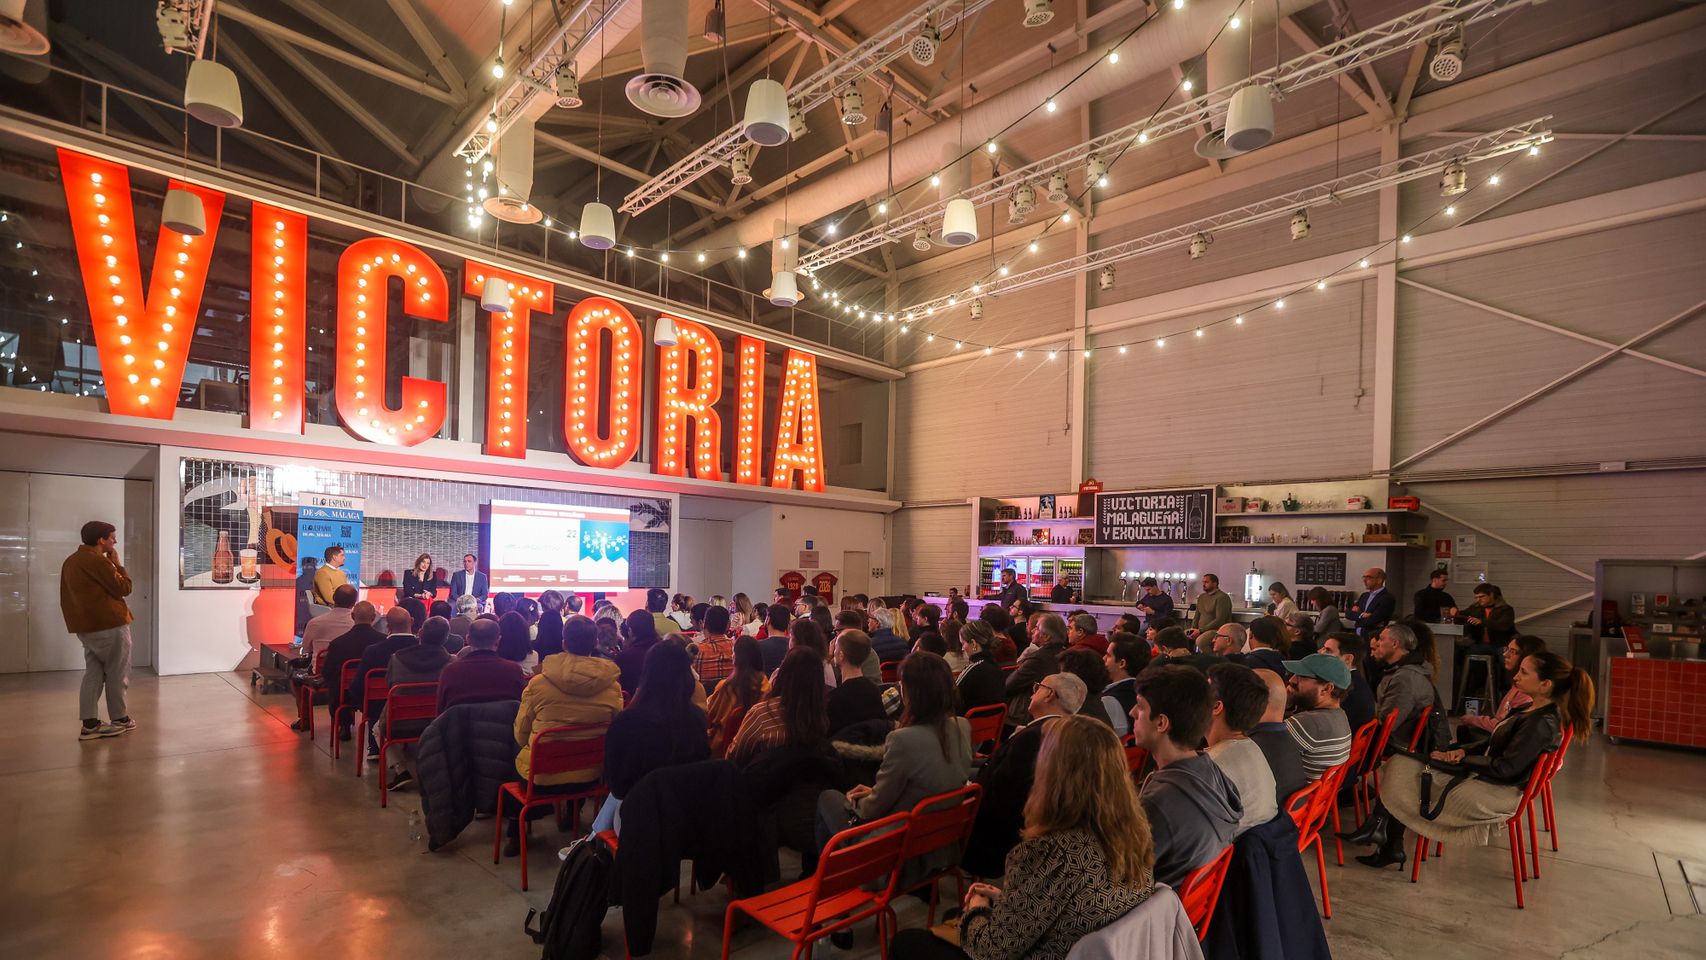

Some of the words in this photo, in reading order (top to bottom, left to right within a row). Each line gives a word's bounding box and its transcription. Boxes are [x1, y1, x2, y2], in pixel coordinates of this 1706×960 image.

[57, 147, 826, 492] VICTORIA
[312, 497, 318, 505] EL
[329, 498, 353, 508] ESPAÑOL
[1111, 495, 1176, 510] VICTORIA
[332, 510, 360, 519] MÁLAGA
[1107, 511, 1180, 525] MALAGUEÑA
[1103, 528, 1111, 540] Y
[1112, 526, 1183, 541] EXQUISITA
